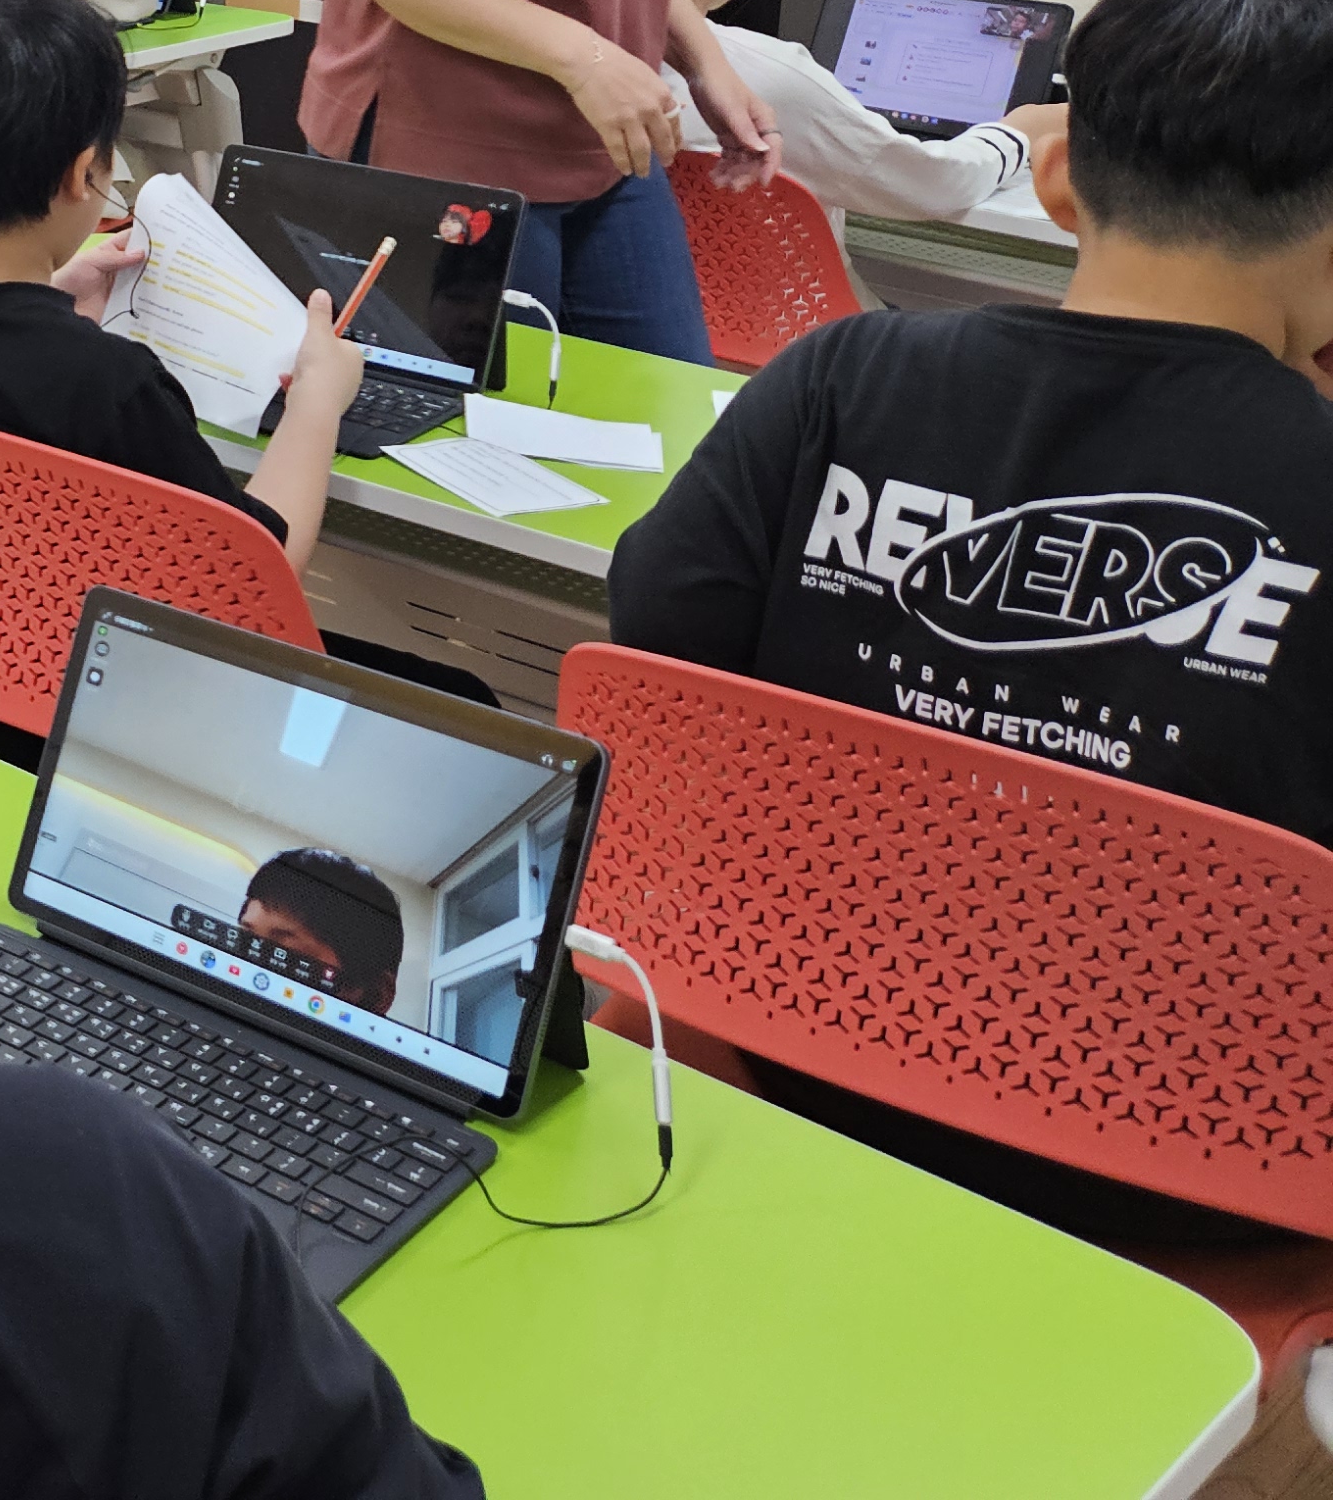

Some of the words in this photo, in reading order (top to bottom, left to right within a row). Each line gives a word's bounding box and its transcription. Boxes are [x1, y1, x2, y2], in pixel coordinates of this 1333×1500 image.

[801, 575, 817, 592] SO
[817, 578, 847, 596] NICE
[802, 563, 834, 579] VERY
[834, 571, 885, 596] FETCHING
[1182, 656, 1227, 678] URBAN
[1229, 665, 1268, 685] WEAR
[857, 642, 1010, 702] URBAN
[1061, 695, 1182, 744] WEAR
[894, 684, 974, 731] VERY
[981, 711, 1132, 770] FETCHING
